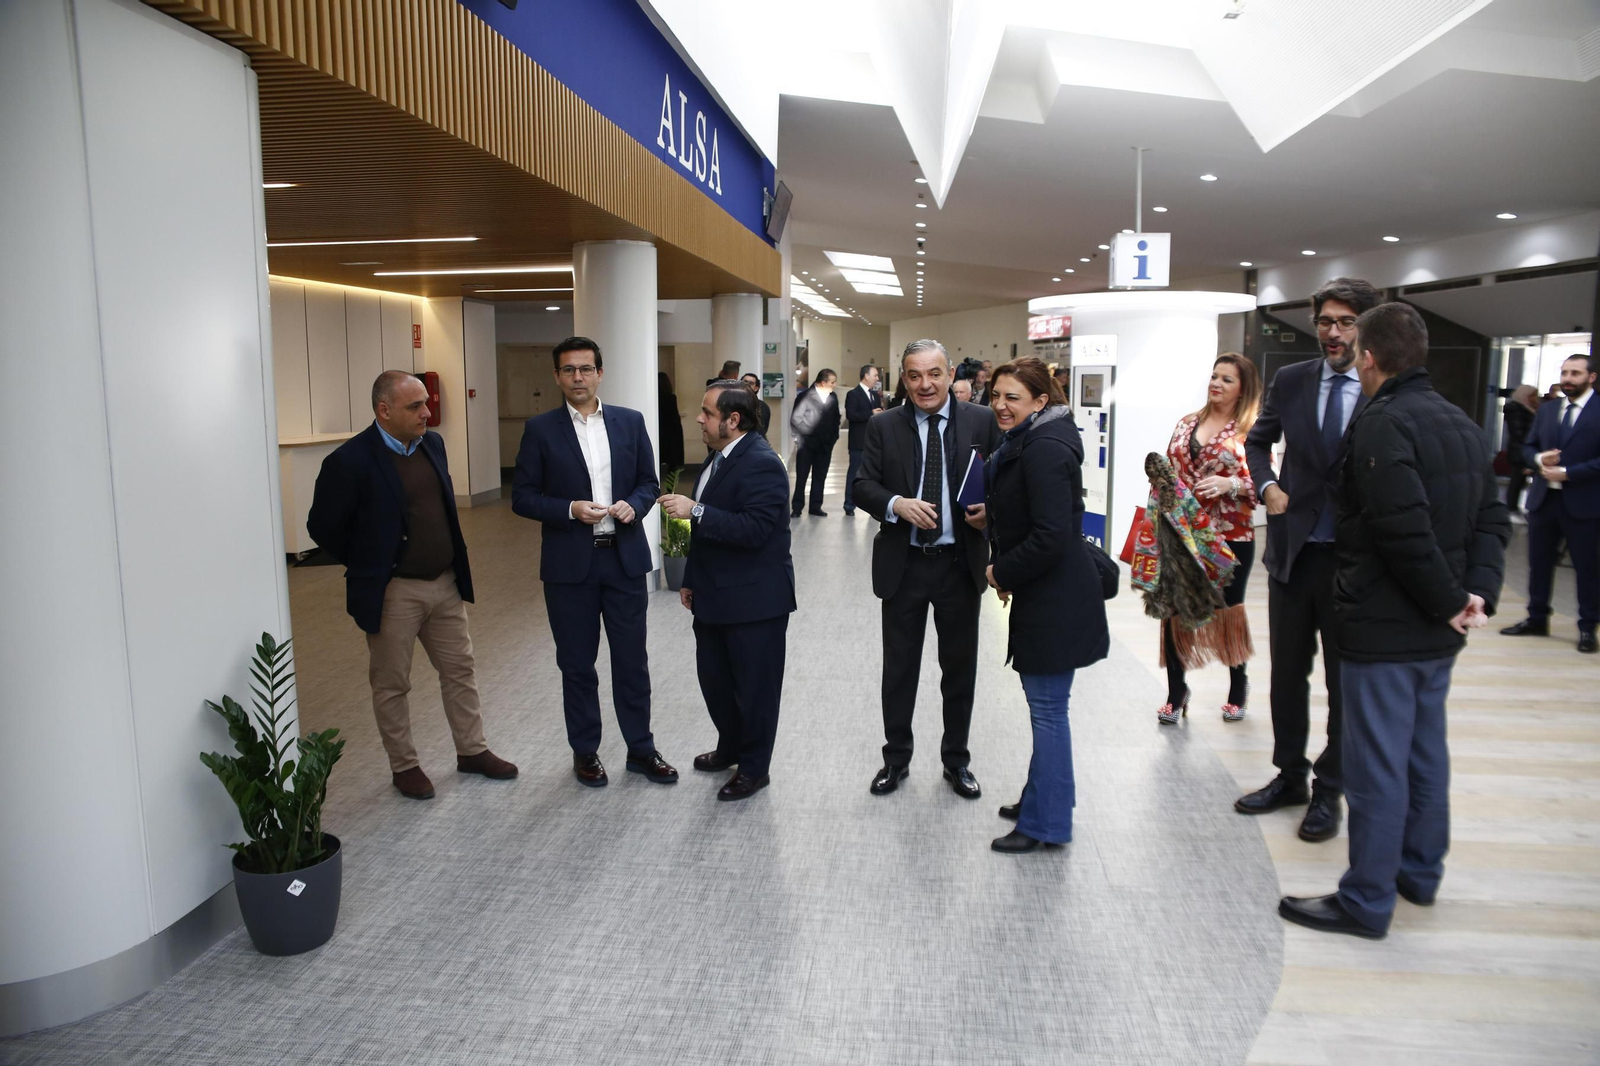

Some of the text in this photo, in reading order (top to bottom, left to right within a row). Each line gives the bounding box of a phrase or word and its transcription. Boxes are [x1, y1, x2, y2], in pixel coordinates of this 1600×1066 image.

[657, 73, 722, 196] ALSA
[1132, 240, 1152, 280] i
[1081, 344, 1109, 357] ALSA
